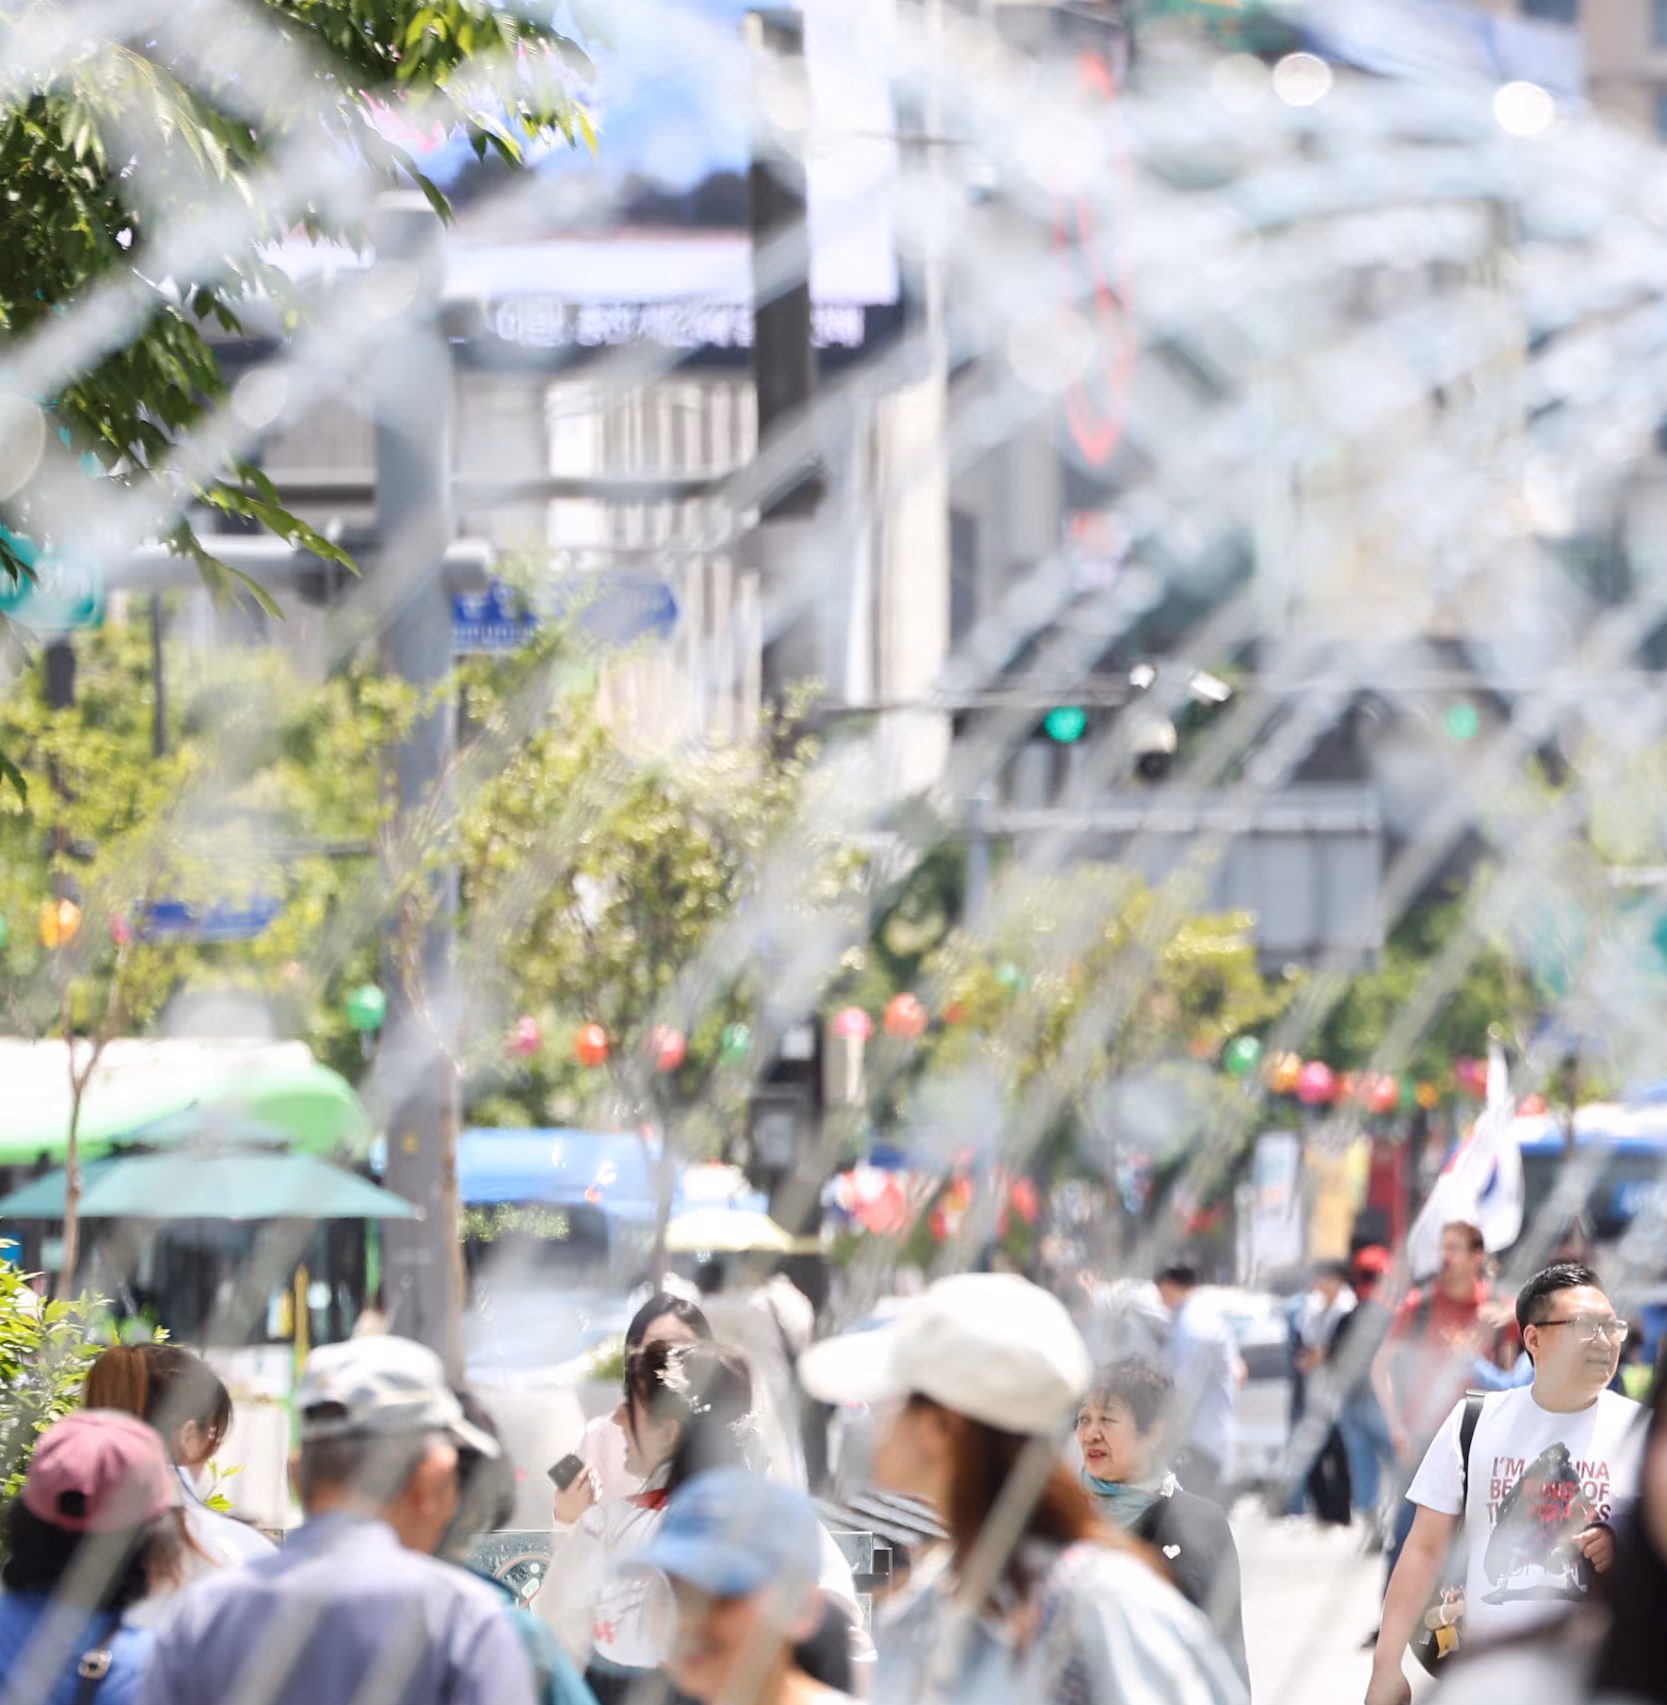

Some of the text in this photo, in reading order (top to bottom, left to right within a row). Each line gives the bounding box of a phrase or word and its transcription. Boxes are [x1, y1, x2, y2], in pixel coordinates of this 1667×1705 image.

[1492, 1456, 1525, 1478] I'M
[1490, 1478, 1513, 1500] BE
[1582, 1481, 1609, 1502] OF
